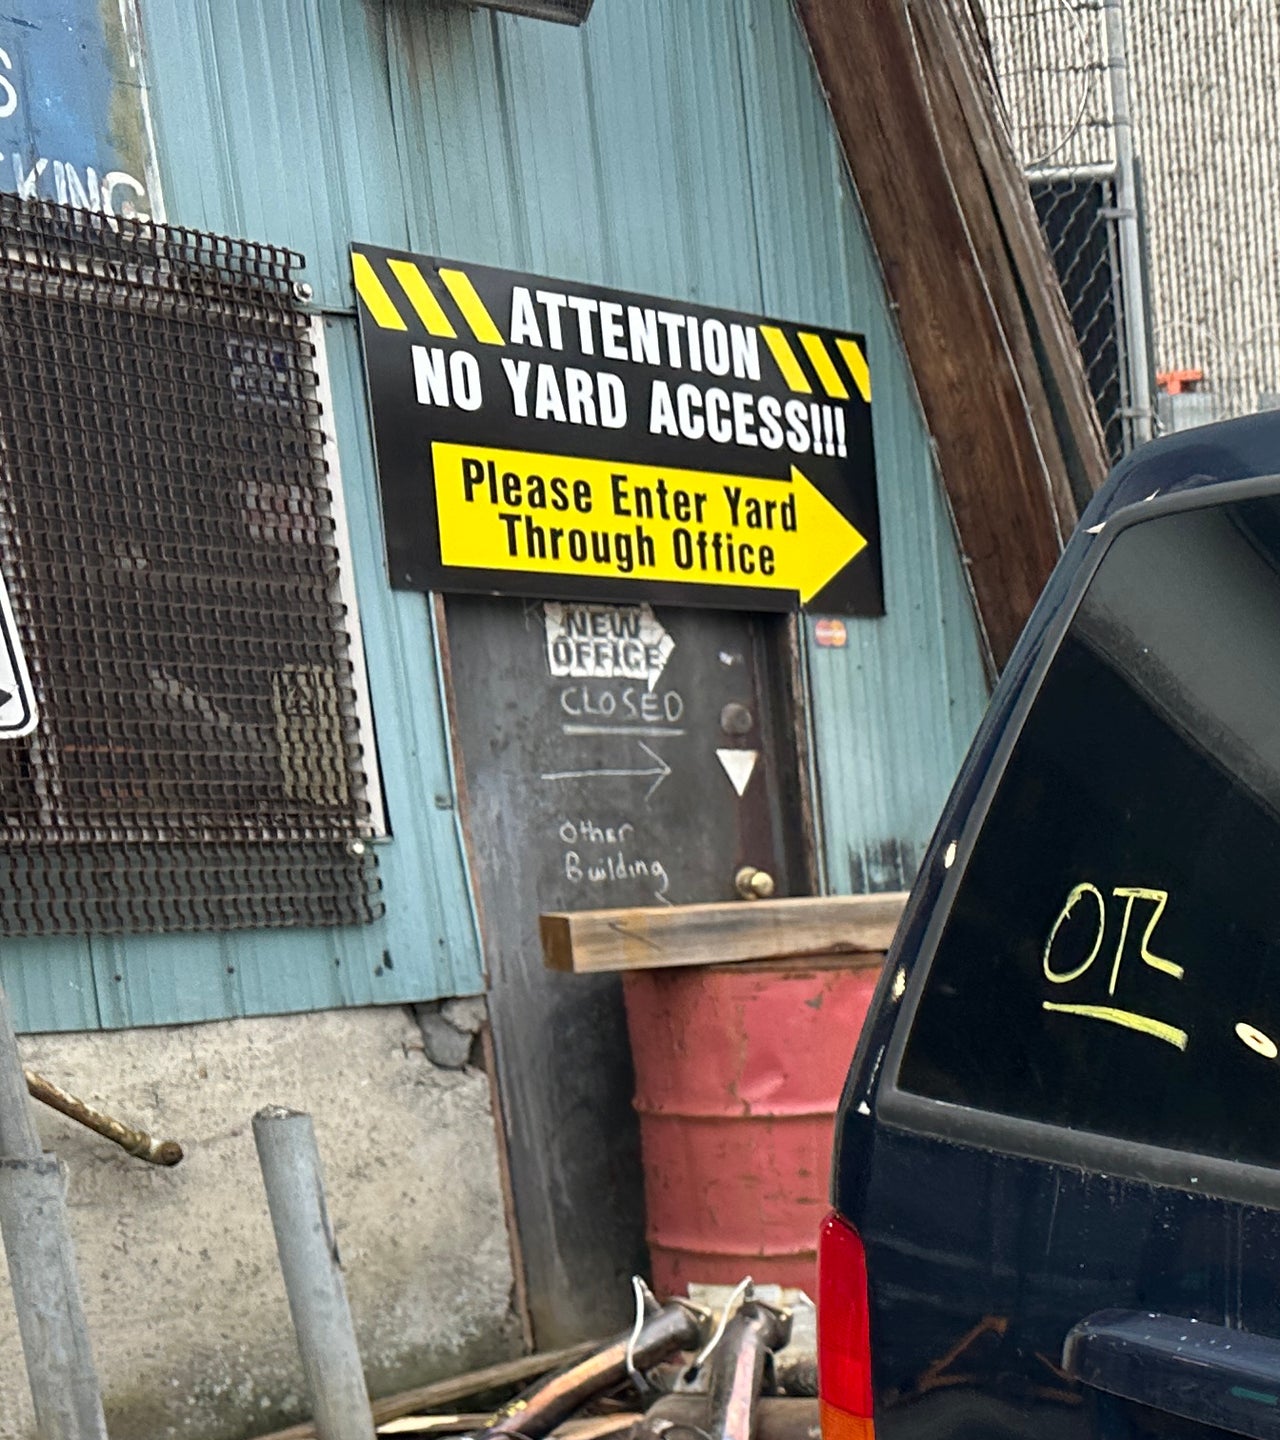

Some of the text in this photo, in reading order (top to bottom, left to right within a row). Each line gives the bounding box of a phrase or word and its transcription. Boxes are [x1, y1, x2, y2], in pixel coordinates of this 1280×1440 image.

[511, 286, 761, 381] ATTENTION
[412, 345, 848, 458] NO YARD ACCESS!!!
[462, 458, 797, 532] Please Enter Yard
[499, 513, 776, 577] Through Office
[567, 610, 641, 638] NEW
[552, 635, 665, 670] OFFICE
[561, 685, 683, 722] CLOSED
[560, 819, 635, 844] Other
[565, 850, 669, 895] Building
